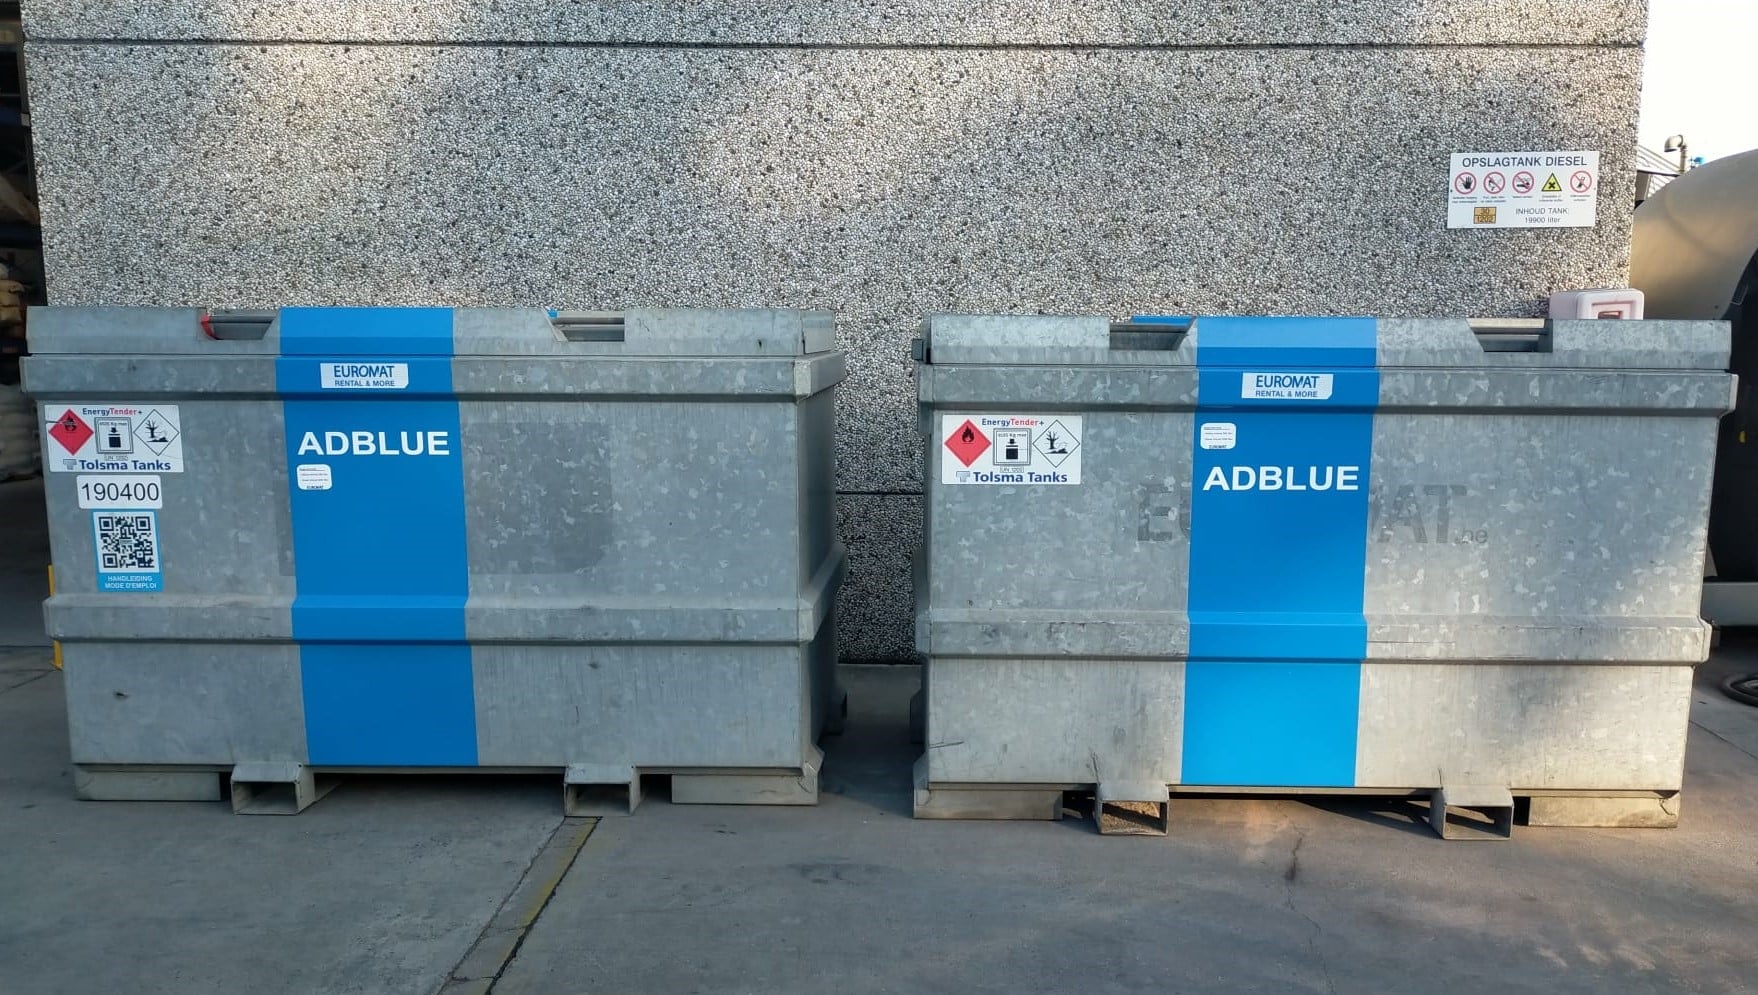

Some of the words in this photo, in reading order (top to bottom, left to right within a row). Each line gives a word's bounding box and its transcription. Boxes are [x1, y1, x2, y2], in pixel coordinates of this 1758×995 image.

[1462, 157, 1541, 167] OPSLAGTANK
[1545, 156, 1587, 166] DIESEL
[333, 365, 395, 378] EUROMAT
[1255, 375, 1320, 388] EUROMAT
[297, 431, 450, 456] ADBLUE
[78, 459, 128, 470] Tolsma
[131, 460, 171, 471] Tanks
[973, 471, 1023, 482] Tolsma
[1027, 472, 1068, 482] Tanks
[1202, 466, 1359, 491] ADBLUE
[81, 482, 159, 501] 190400
